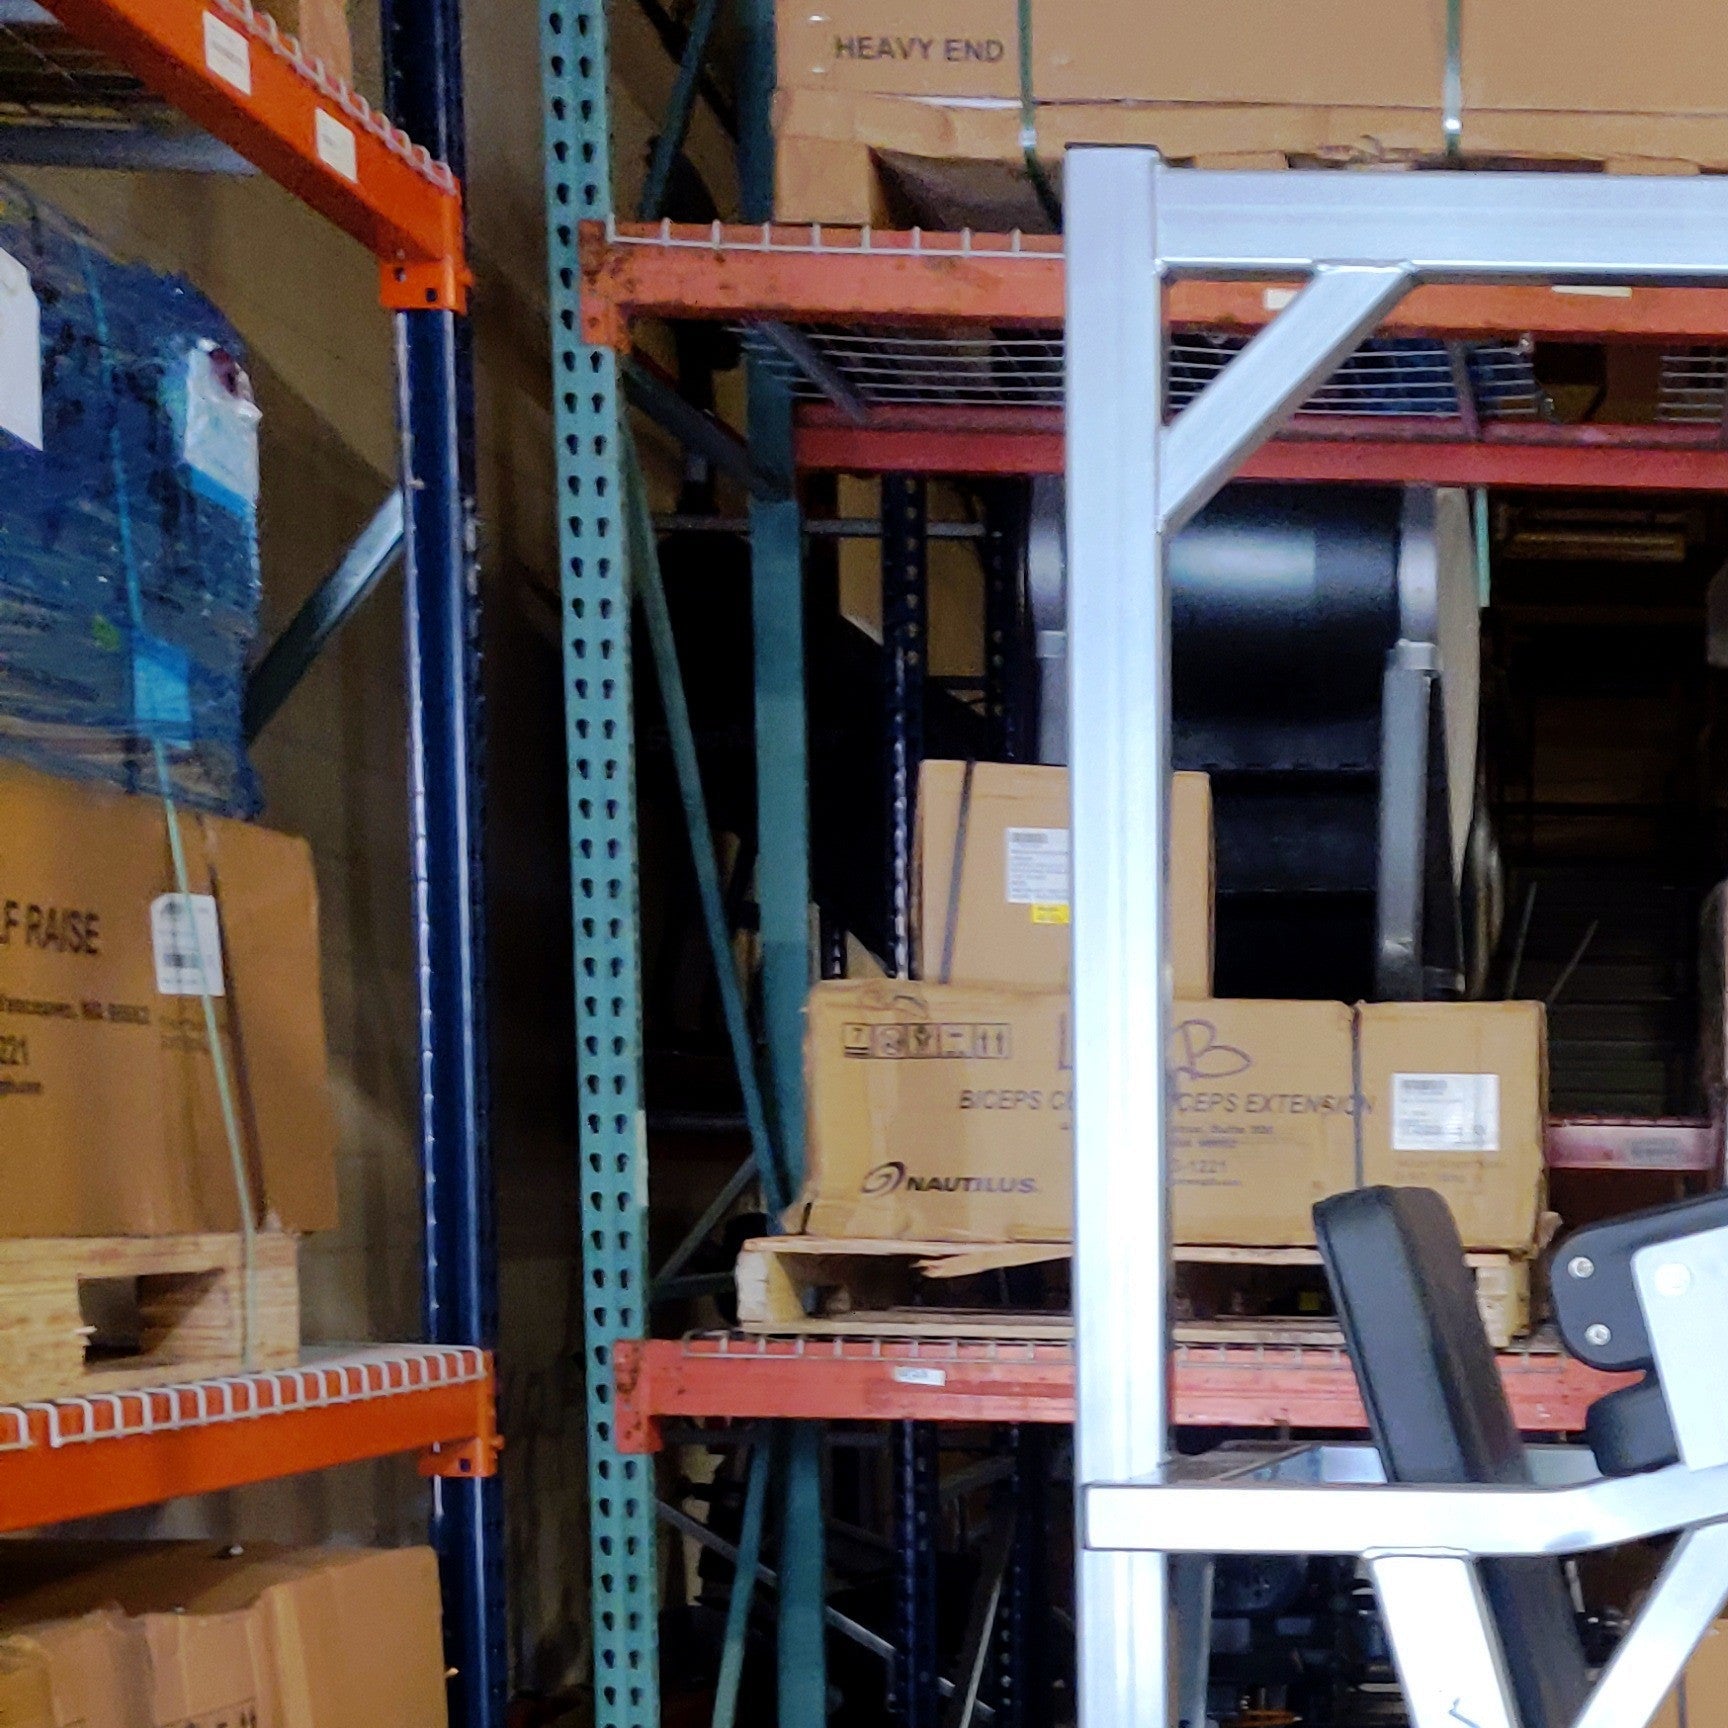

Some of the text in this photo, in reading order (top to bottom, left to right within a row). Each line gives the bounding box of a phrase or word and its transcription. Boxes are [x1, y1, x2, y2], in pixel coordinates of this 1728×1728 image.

[834, 34, 1004, 63] HEAVY END
[26, 903, 99, 955] RAISE
[958, 1089, 1043, 1110] BICEPS
